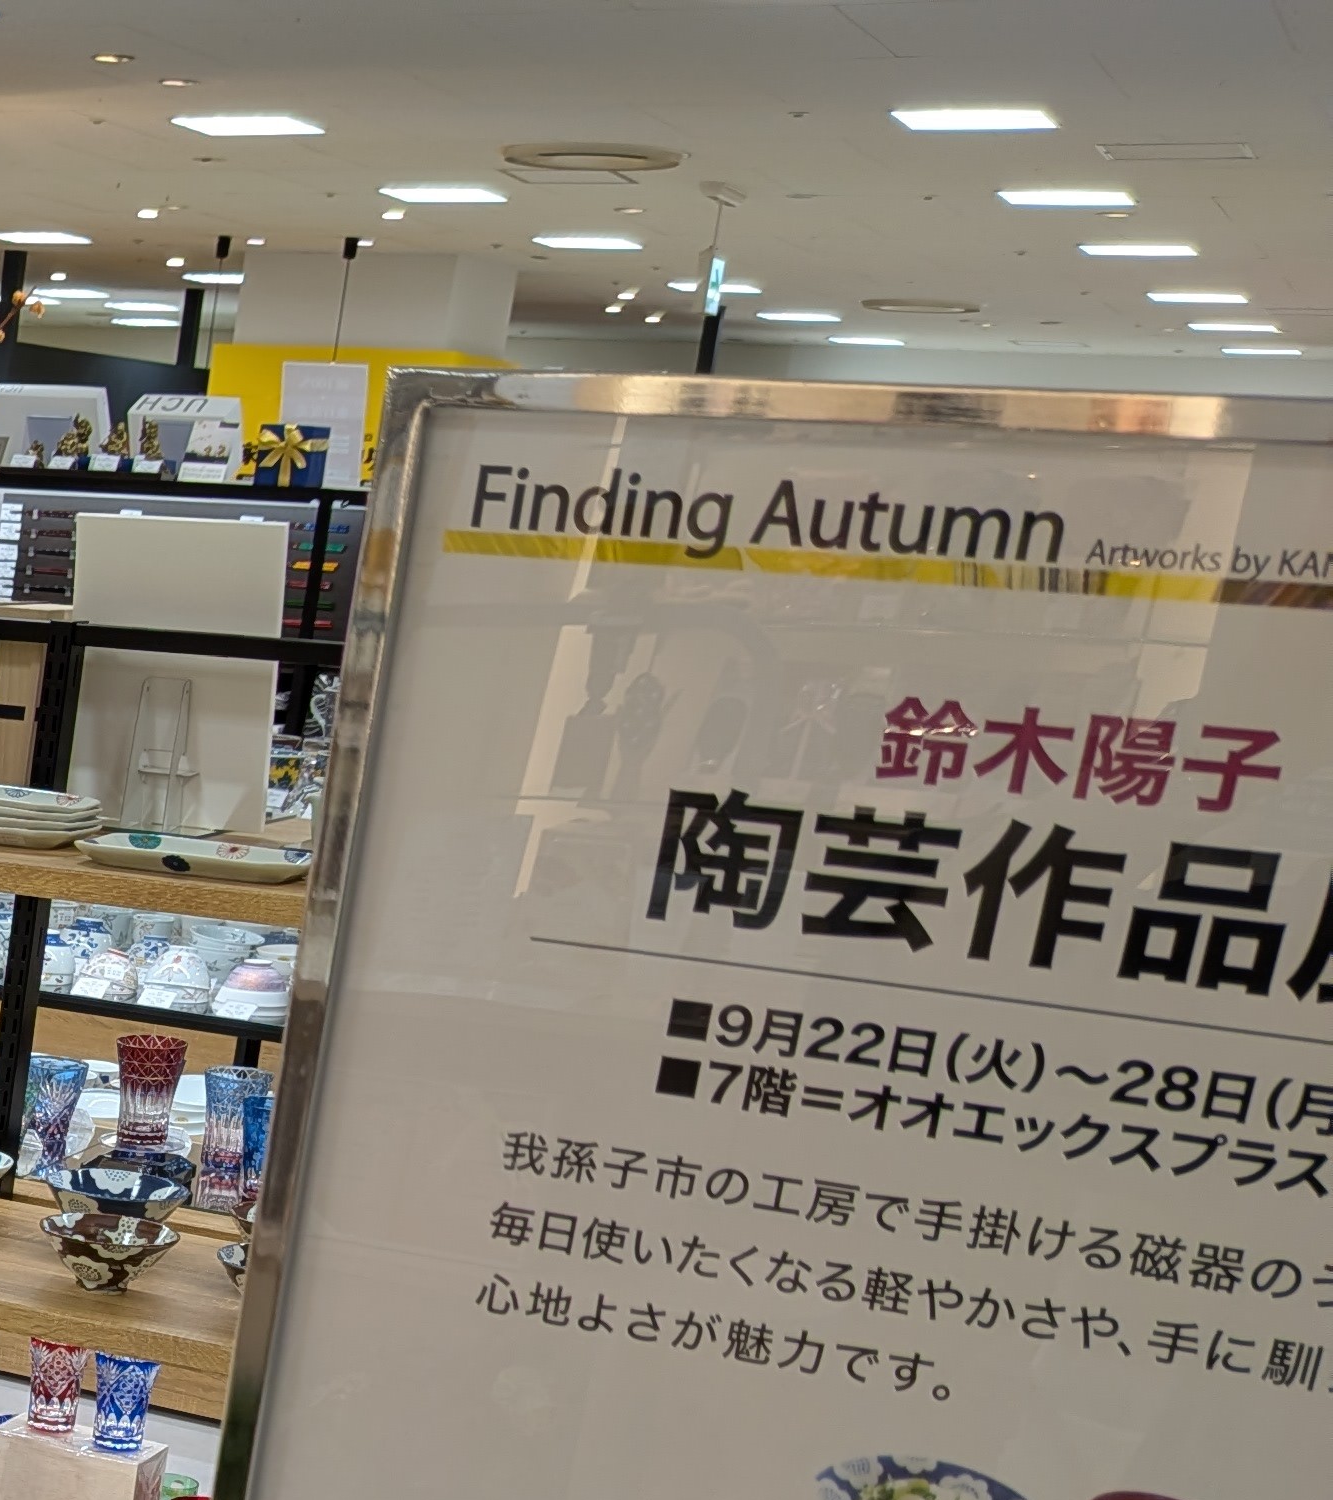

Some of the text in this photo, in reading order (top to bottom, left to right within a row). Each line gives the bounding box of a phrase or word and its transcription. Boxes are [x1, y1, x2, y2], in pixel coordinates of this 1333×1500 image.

[470, 465, 1066, 563] Finding Autumn
[1085, 539, 1221, 572] Artworks
[1231, 545, 1271, 581] by
[876, 696, 1282, 813] 鈴木陽子
[473, 1271, 952, 1402] 心地よさが魅力です。
[487, 1202, 1333, 1394] 毎日使いたくなる軽やかさや、手に馴
